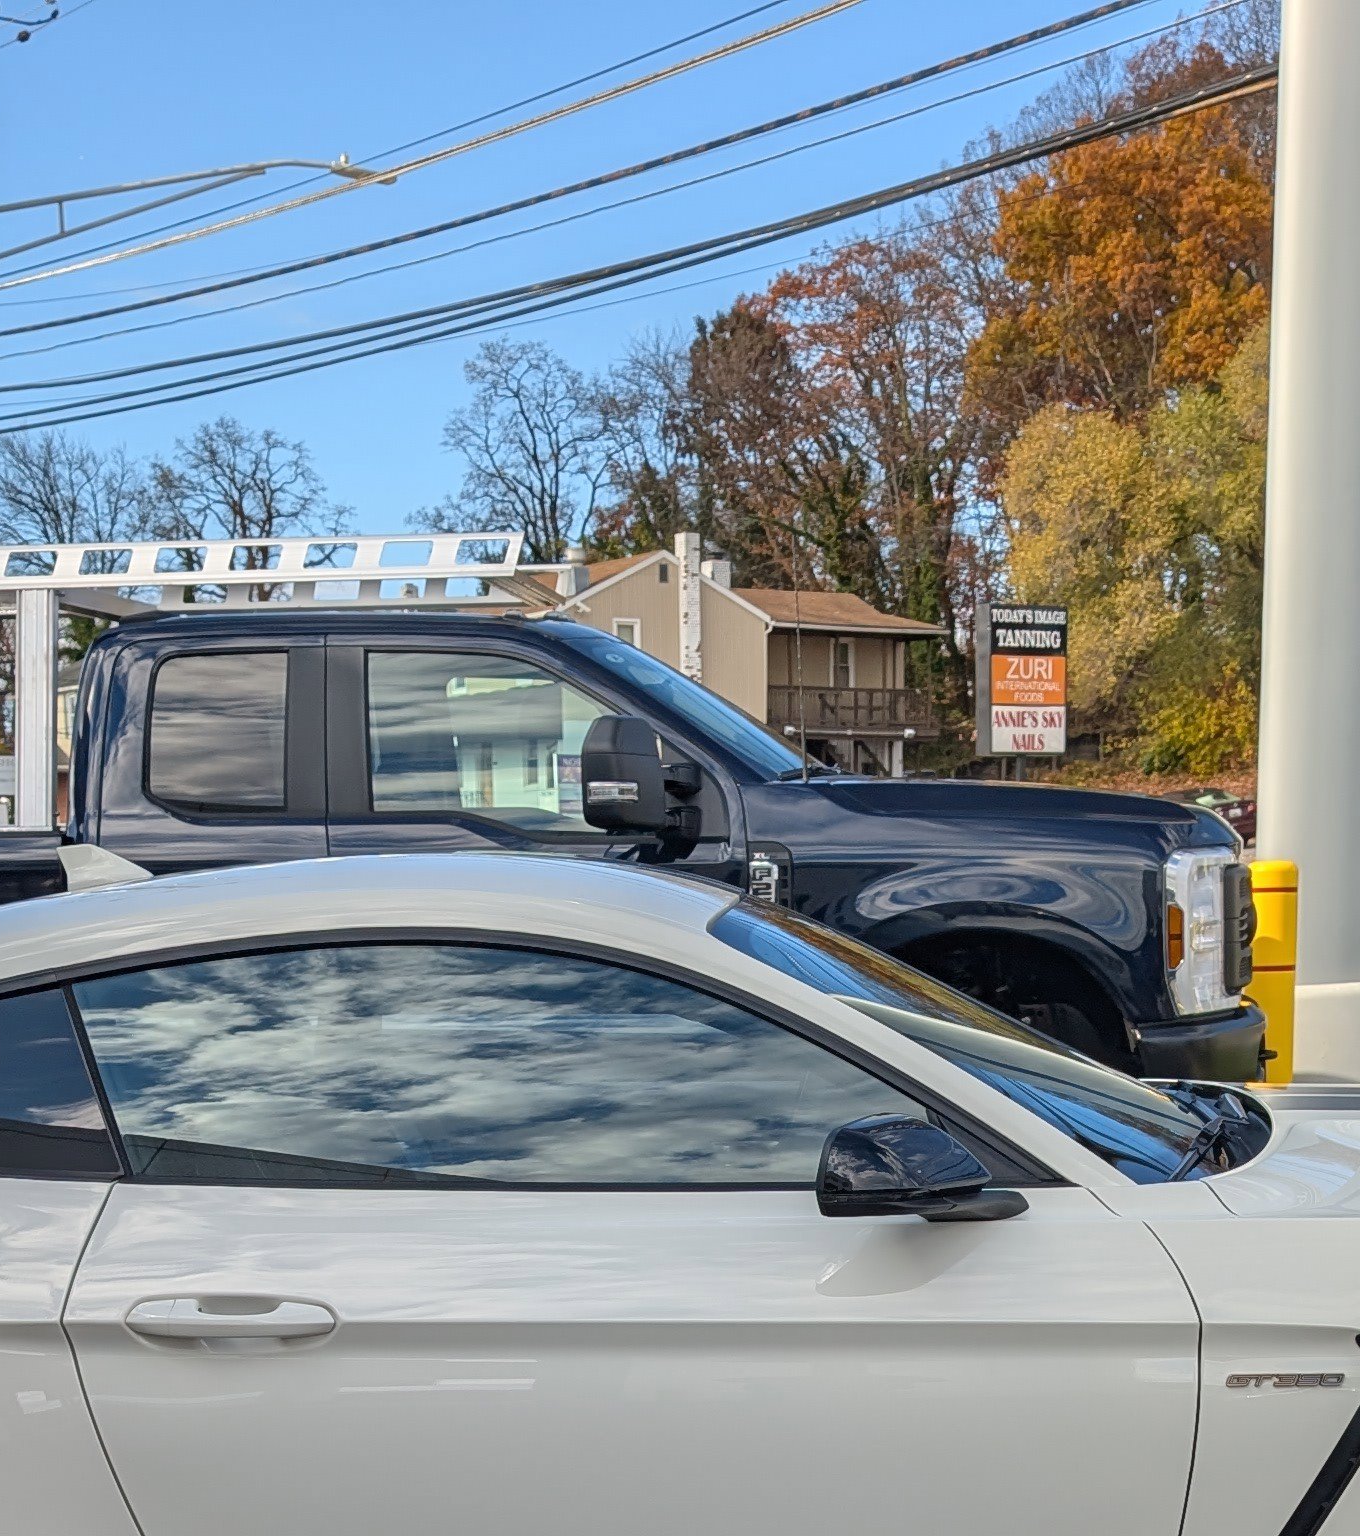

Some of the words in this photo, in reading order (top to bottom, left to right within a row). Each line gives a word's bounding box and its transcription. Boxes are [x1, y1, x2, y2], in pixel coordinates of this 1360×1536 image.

[992, 609, 1034, 623] TODAY'S
[1034, 610, 1066, 625] IMAGE
[995, 629, 1062, 649] TANNING
[1006, 658, 1053, 680] ZURI
[995, 681, 1061, 691] INTERNATIONAL
[1013, 692, 1044, 702] FOODS
[994, 711, 1039, 728] ANNIE'S
[1041, 711, 1063, 728] SKY
[1012, 733, 1045, 751] NAILS
[753, 852, 770, 860] XL
[1226, 1373, 1345, 1388] GT350
